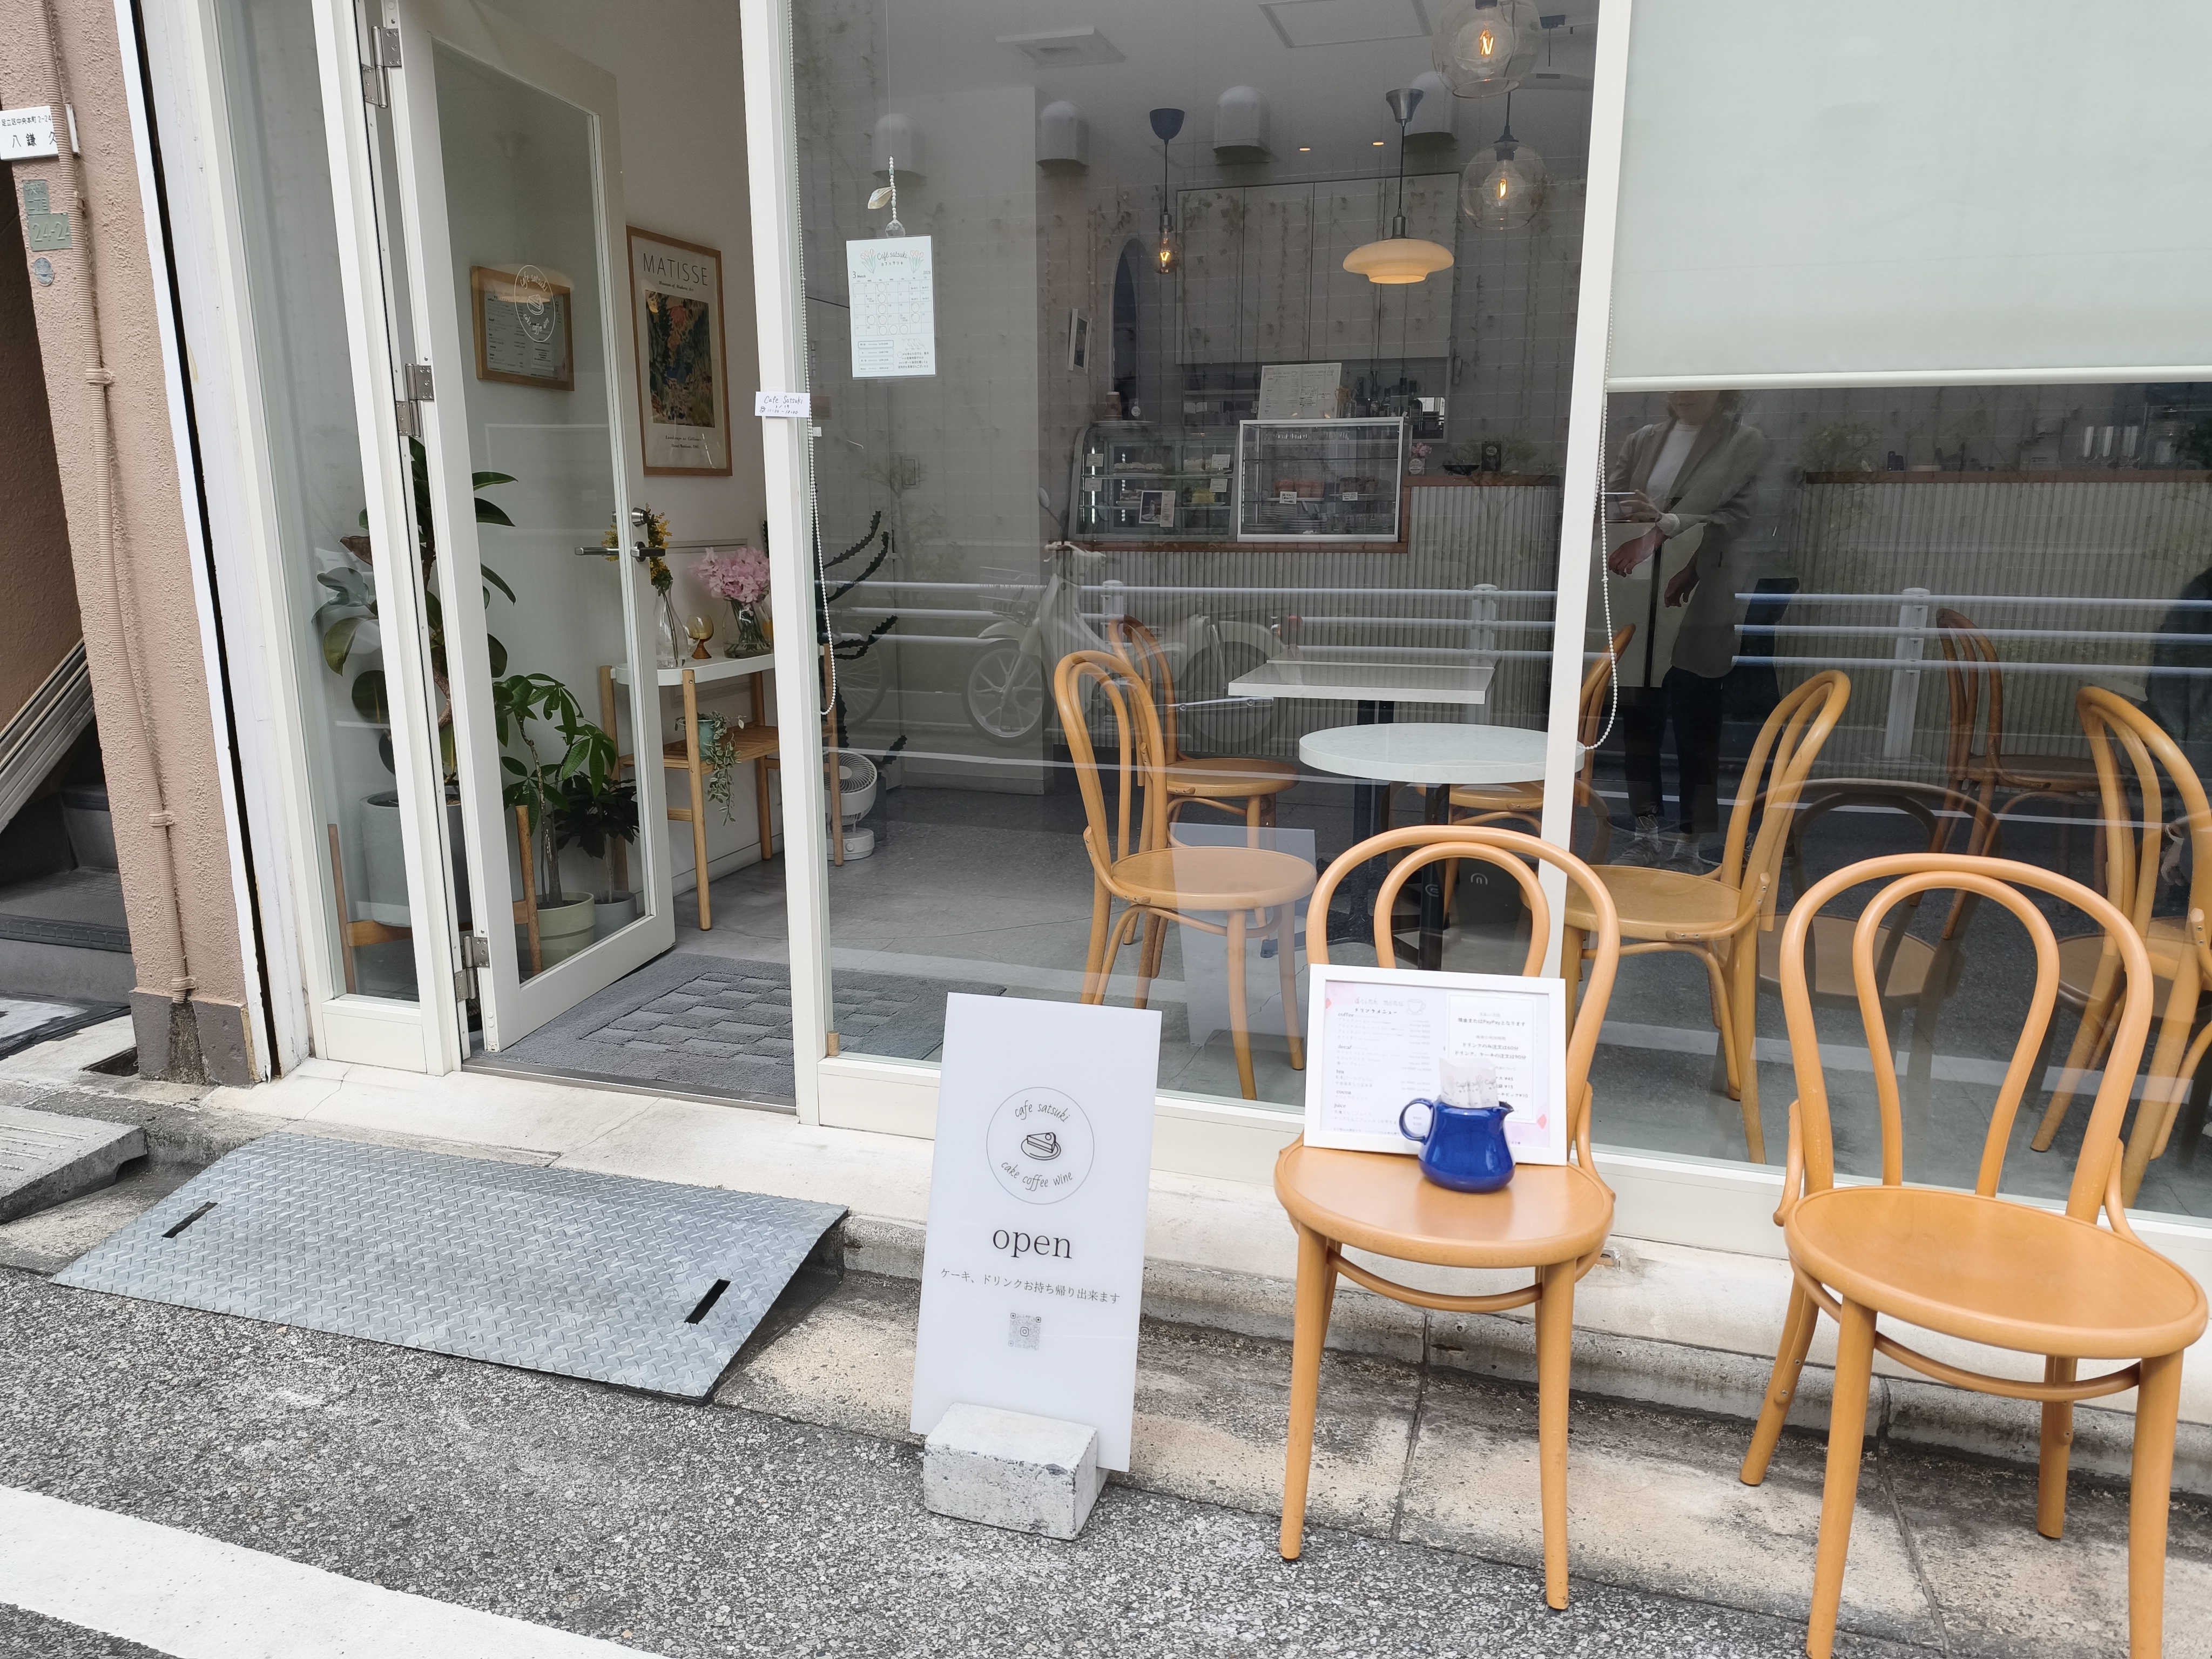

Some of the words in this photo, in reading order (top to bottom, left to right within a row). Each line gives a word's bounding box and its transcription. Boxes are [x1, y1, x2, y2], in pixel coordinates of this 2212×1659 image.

[520, 271, 529, 289] cafe
[531, 274, 548, 292] satsuki
[643, 253, 708, 286] MATISSE
[783, 395, 803, 404] Satsuki
[1014, 1099, 1033, 1121] cafe
[1037, 1102, 1071, 1123] satsuki
[1001, 1159, 1021, 1179] cake
[1022, 1174, 1049, 1192] coffee
[1053, 1170, 1074, 1187] wine
[992, 1228, 1073, 1260] open
[940, 1267, 1121, 1305] ケーキ、ドリンクお持ち帰り出来ます
